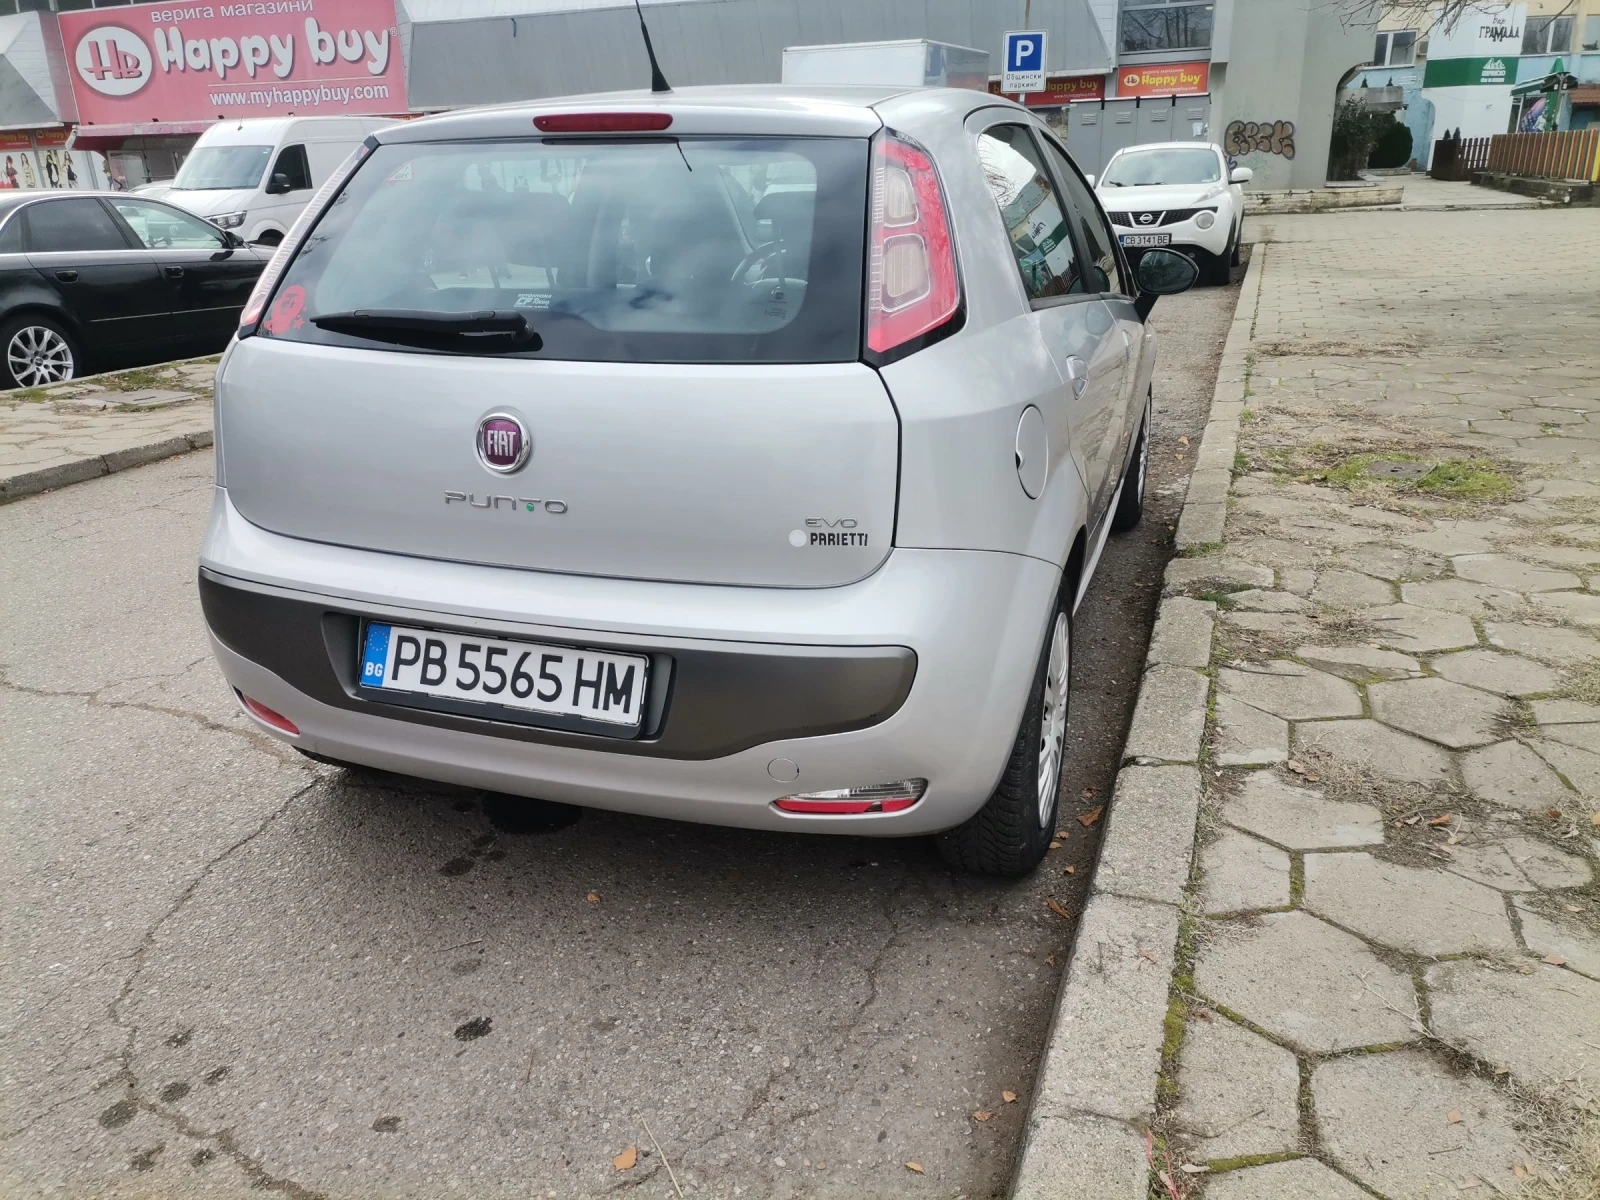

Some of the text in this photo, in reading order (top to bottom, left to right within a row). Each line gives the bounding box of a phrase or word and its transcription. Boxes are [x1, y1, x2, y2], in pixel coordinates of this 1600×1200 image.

[151, 0, 314, 24] верига магазини
[154, 26, 293, 79] Happy
[1016, 40, 1034, 67] P
[1080, 79, 1099, 91] buy
[1141, 74, 1177, 86] Happy
[209, 84, 389, 108] www.myhappybuy.com
[1125, 236, 1168, 244] CB 3141 BE
[487, 430, 516, 457] FIAT
[445, 490, 568, 514] PUNTO
[805, 517, 858, 529] EVO
[810, 532, 869, 547] PARIETTI
[365, 661, 383, 678] BG
[391, 634, 636, 714] PB 5565 HM
